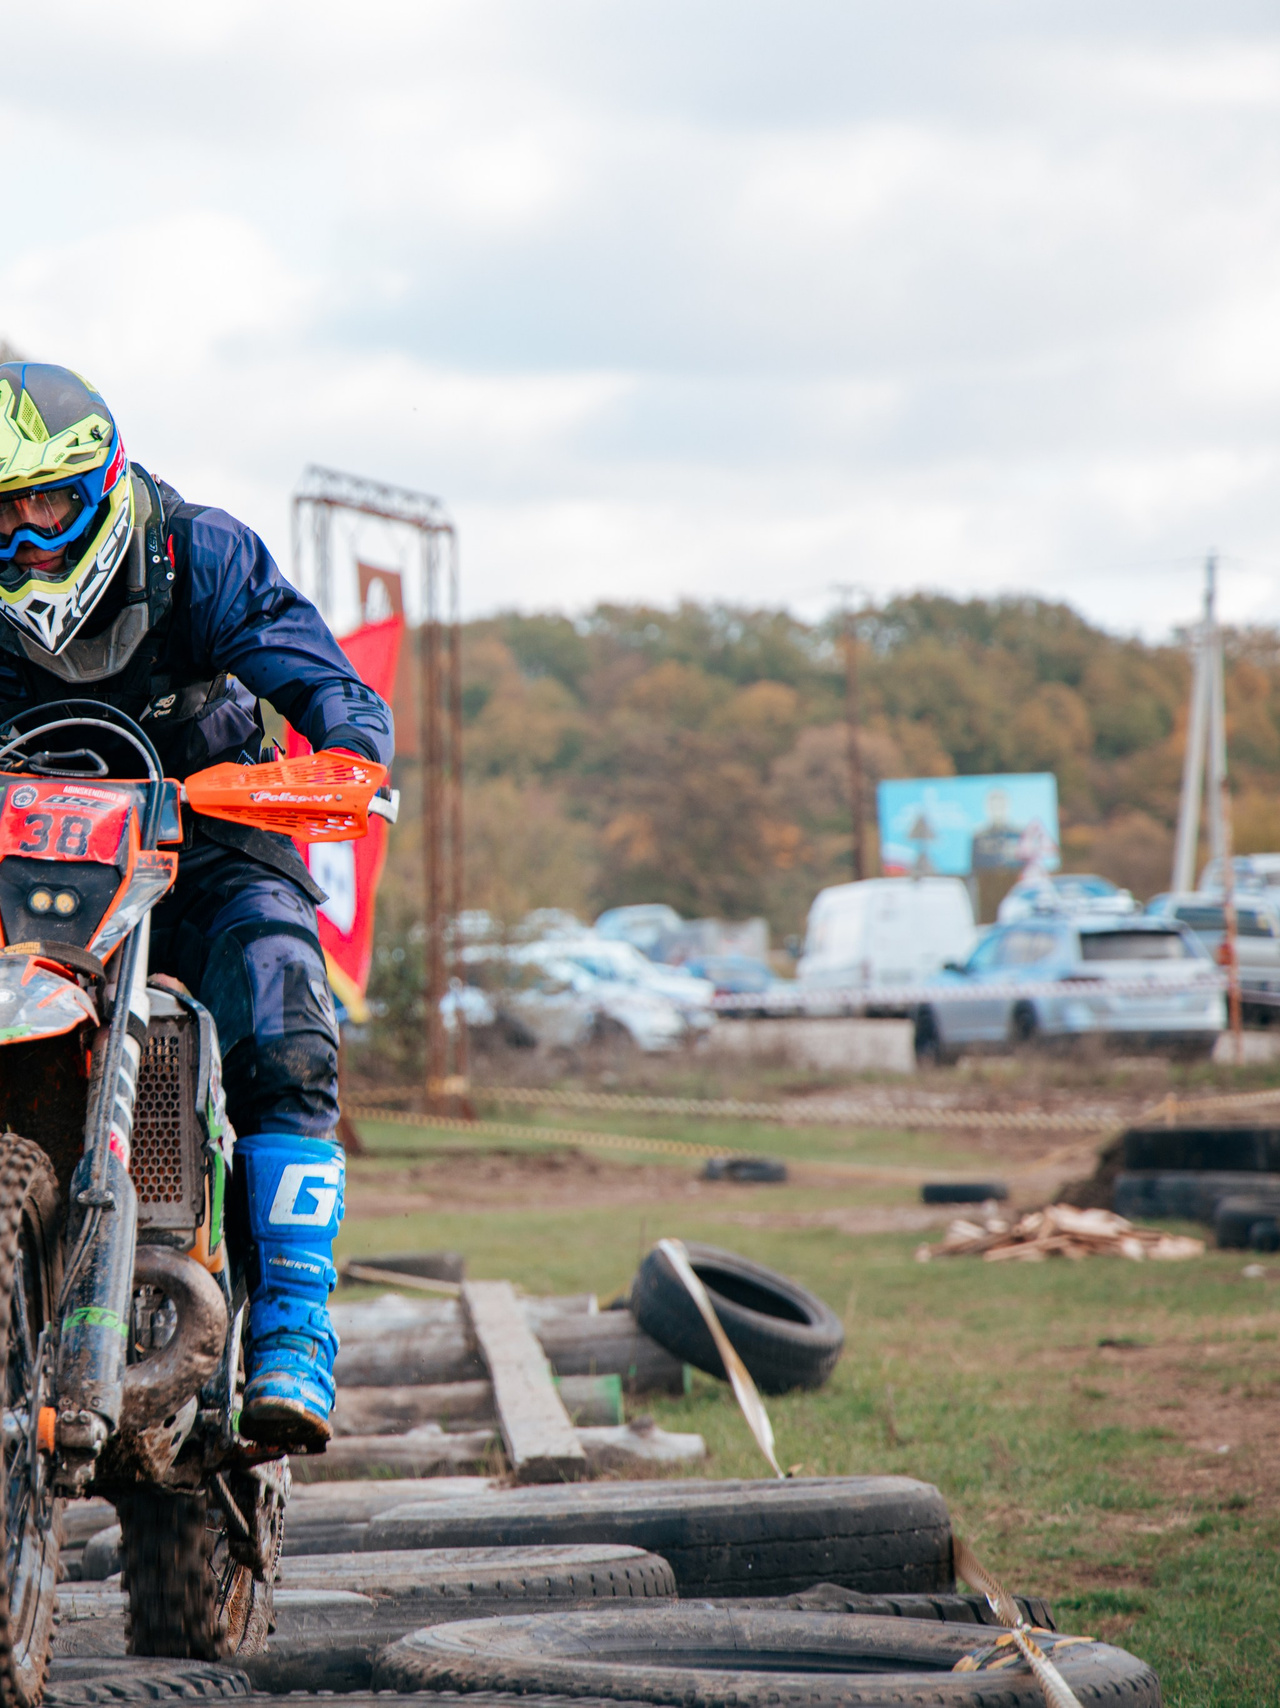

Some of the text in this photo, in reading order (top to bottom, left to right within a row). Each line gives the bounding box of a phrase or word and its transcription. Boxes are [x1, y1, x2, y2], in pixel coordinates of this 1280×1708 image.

[19, 813, 93, 856] 38
[137, 855, 173, 867] KTM
[268, 1164, 340, 1227] G
